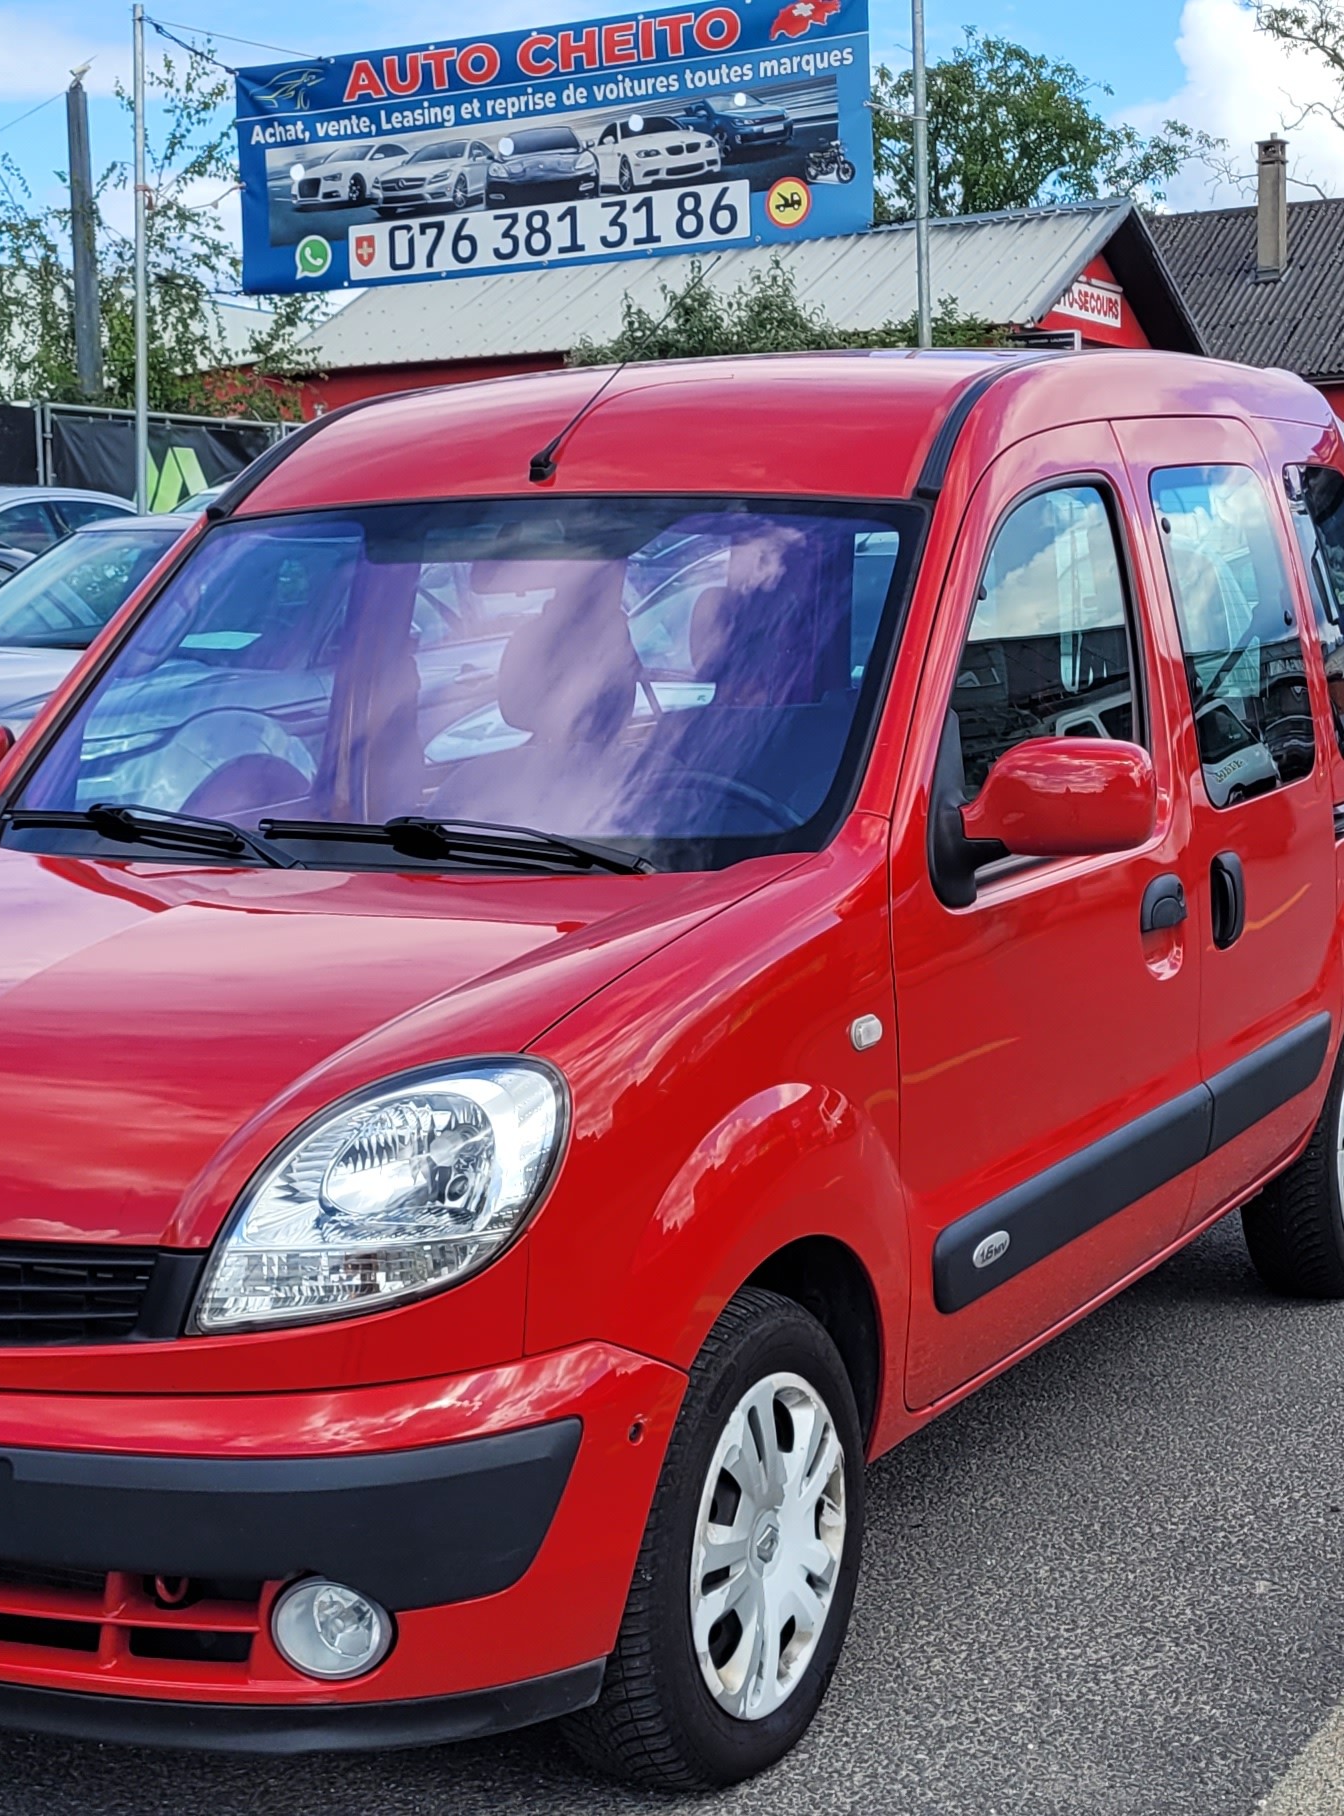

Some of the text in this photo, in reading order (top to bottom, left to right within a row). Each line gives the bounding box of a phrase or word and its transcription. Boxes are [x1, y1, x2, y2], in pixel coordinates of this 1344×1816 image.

[251, 47, 854, 145] Achat, vente, Leasing et reprise de voitures toutes marques
[343, 7, 741, 103] AUTO CHEITO
[388, 186, 738, 271] 076 381 31 86
